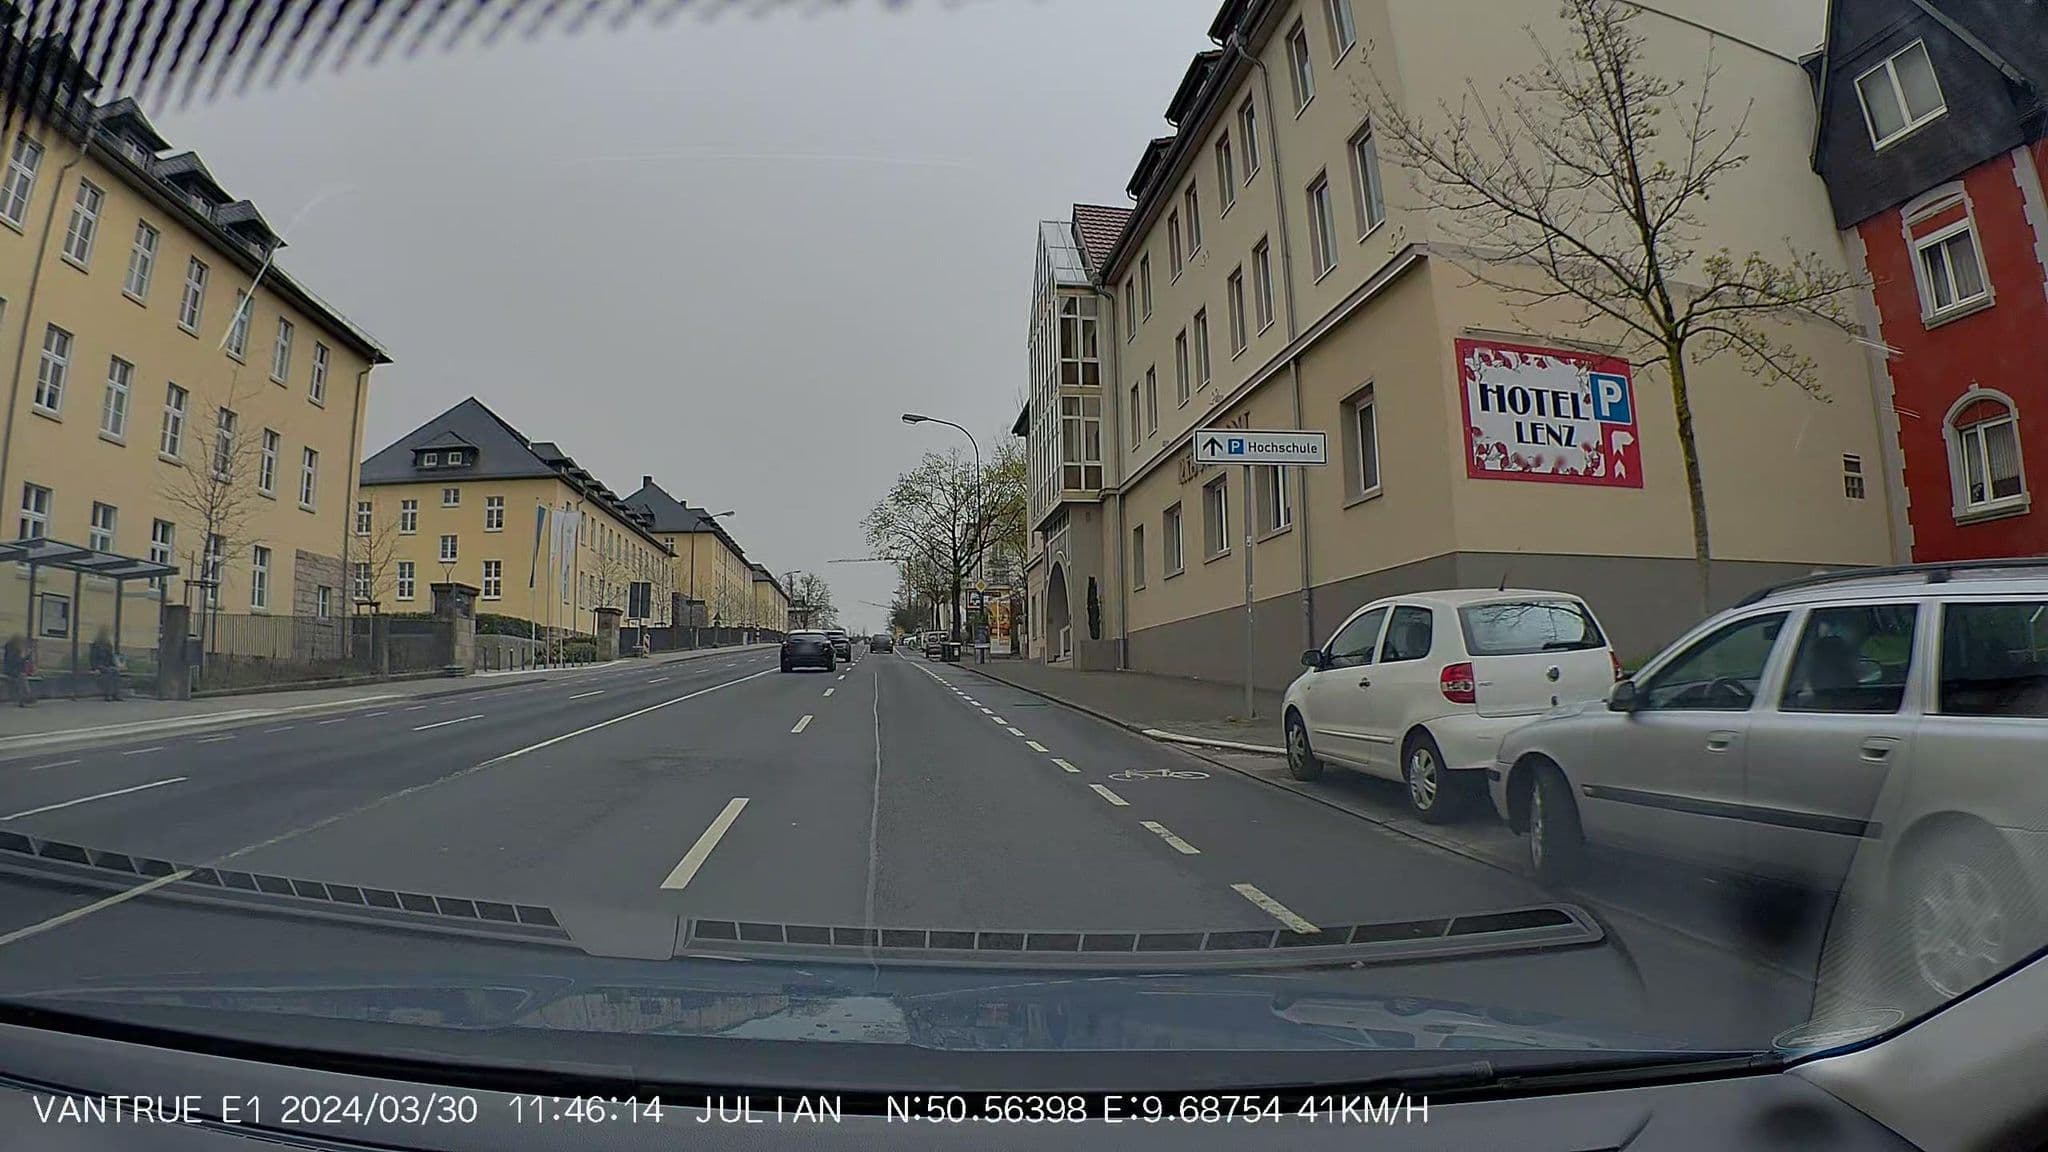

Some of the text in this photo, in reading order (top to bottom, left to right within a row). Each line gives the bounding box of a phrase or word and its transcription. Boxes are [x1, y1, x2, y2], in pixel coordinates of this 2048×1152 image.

[1478, 383, 1590, 421] HOTEL
[1597, 378, 1623, 417] P
[1248, 441, 1318, 454] Hochschule
[1514, 421, 1578, 448] LENZ
